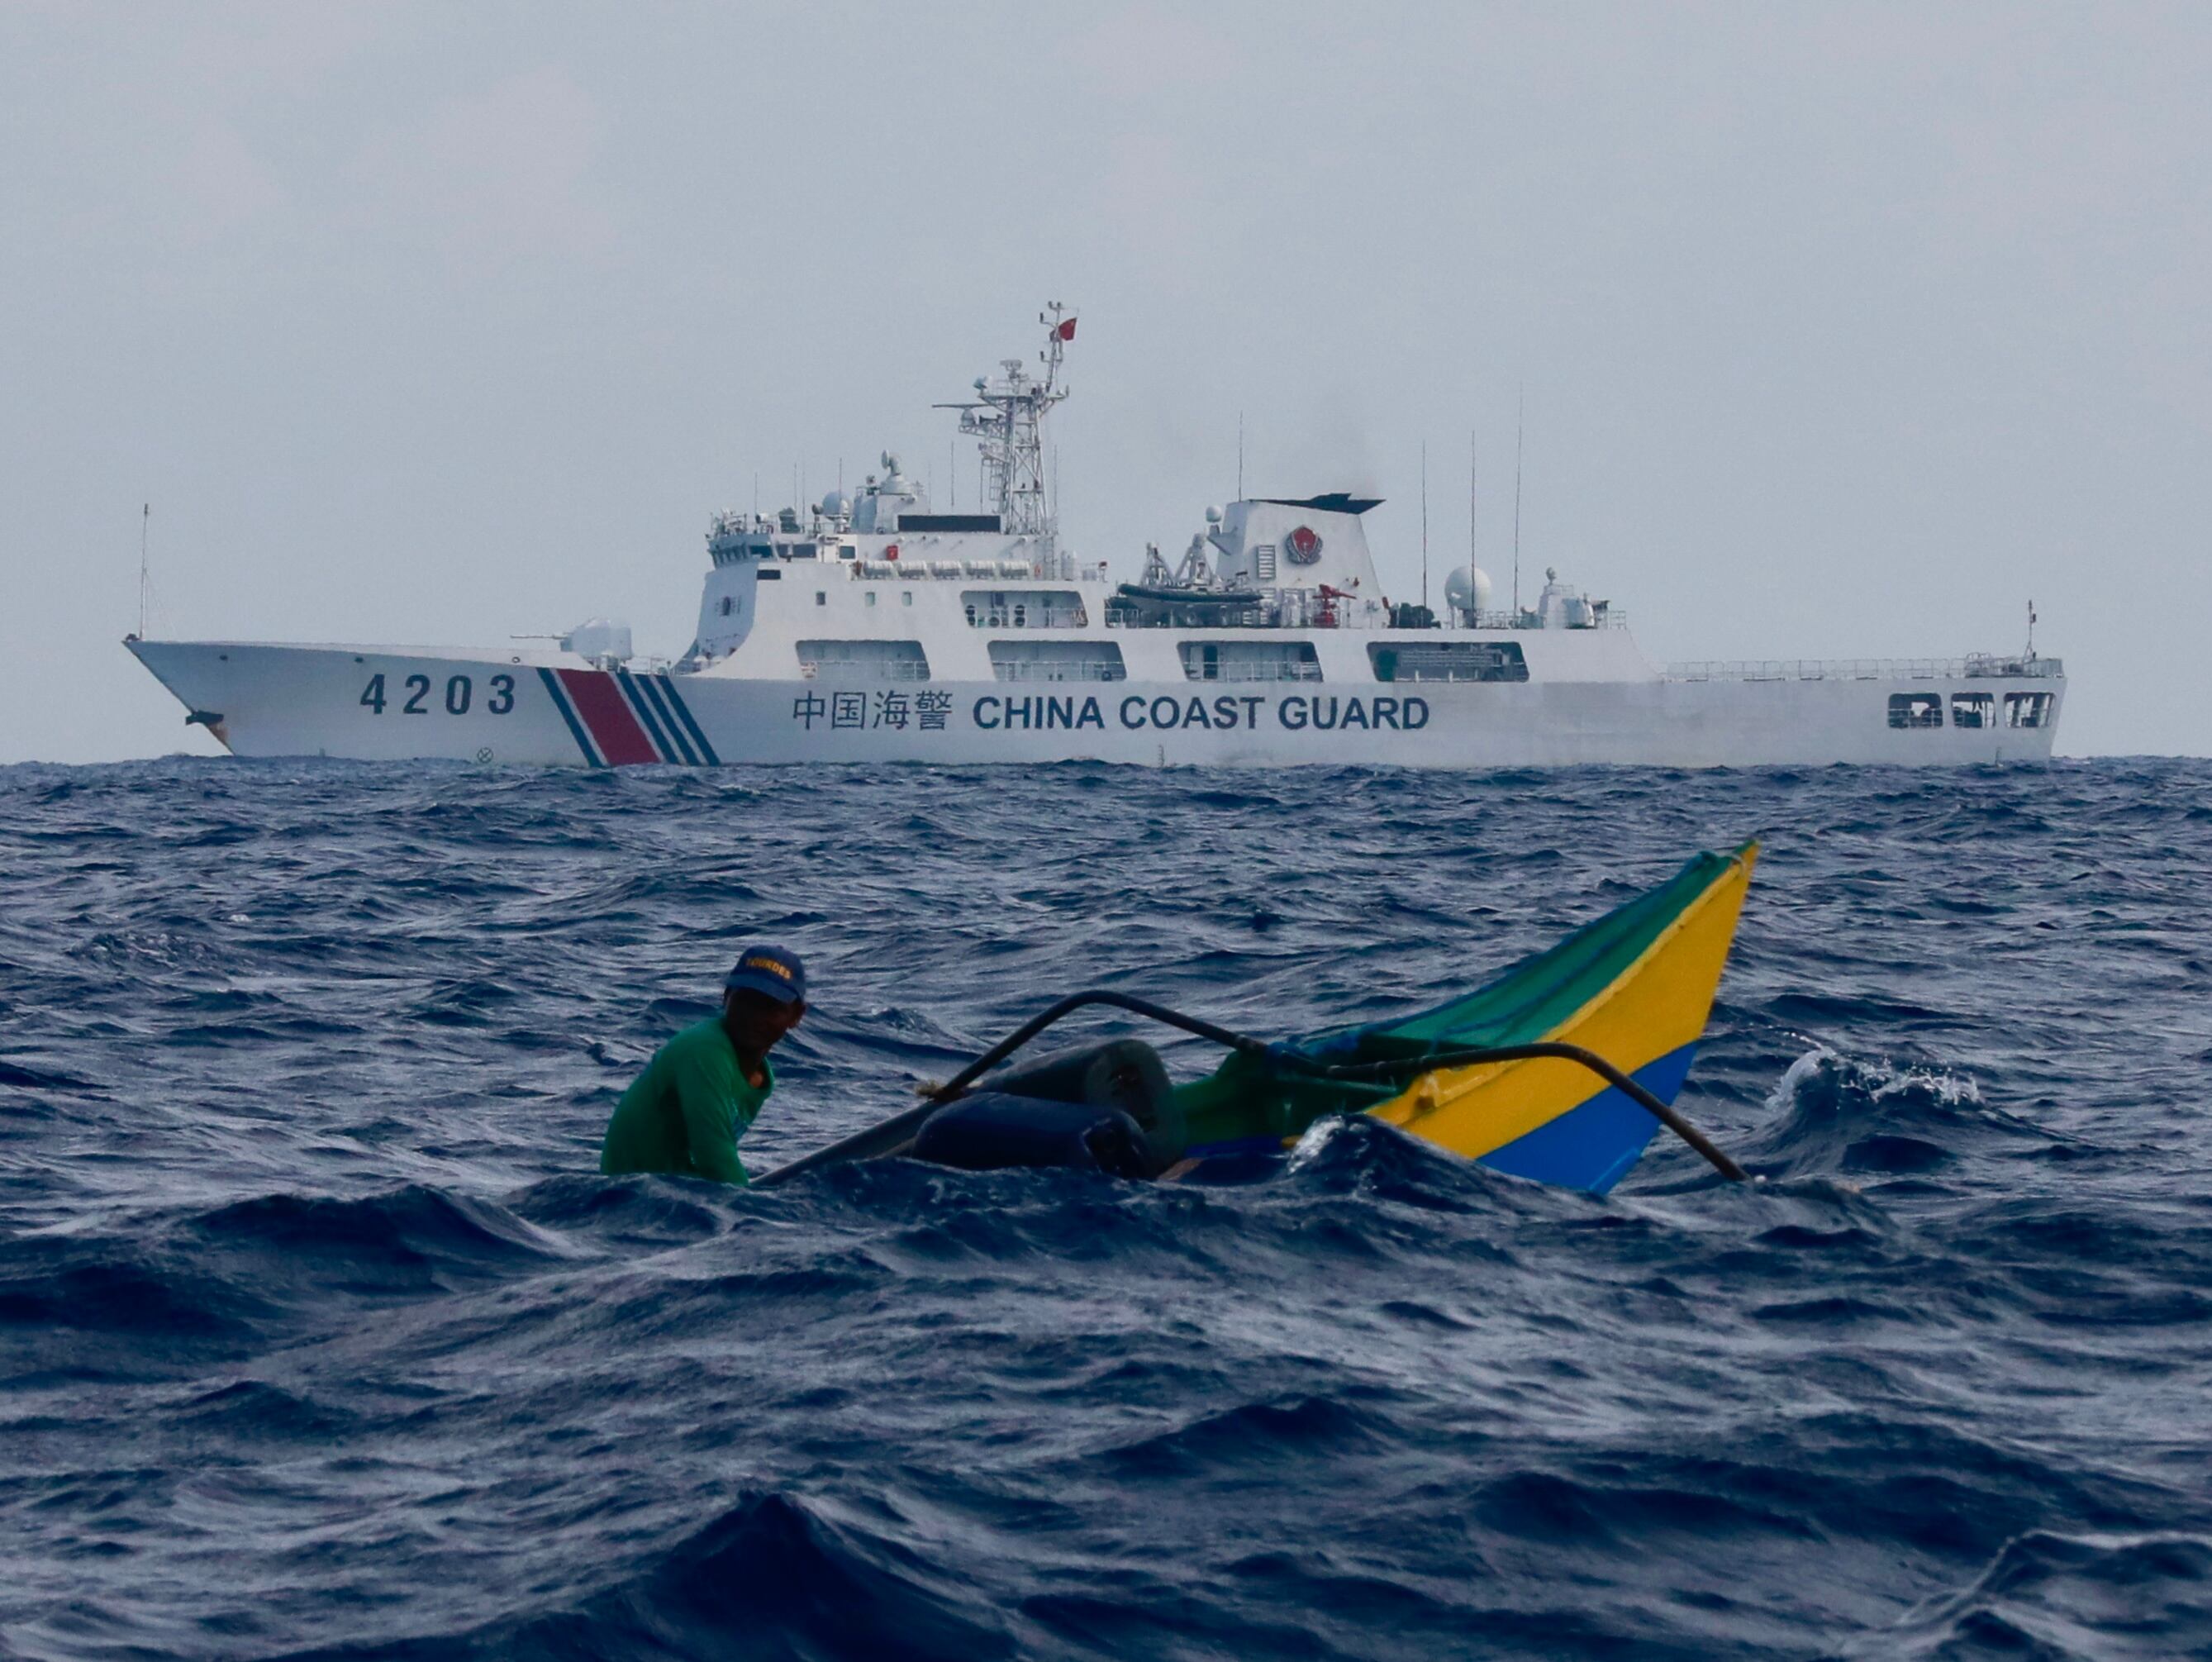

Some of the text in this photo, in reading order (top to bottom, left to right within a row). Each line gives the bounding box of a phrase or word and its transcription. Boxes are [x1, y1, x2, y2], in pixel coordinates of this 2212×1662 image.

[359, 674, 516, 716] 4203
[792, 690, 953, 731] 中国海警
[973, 695, 1429, 730] CHINA COAST GUARD
